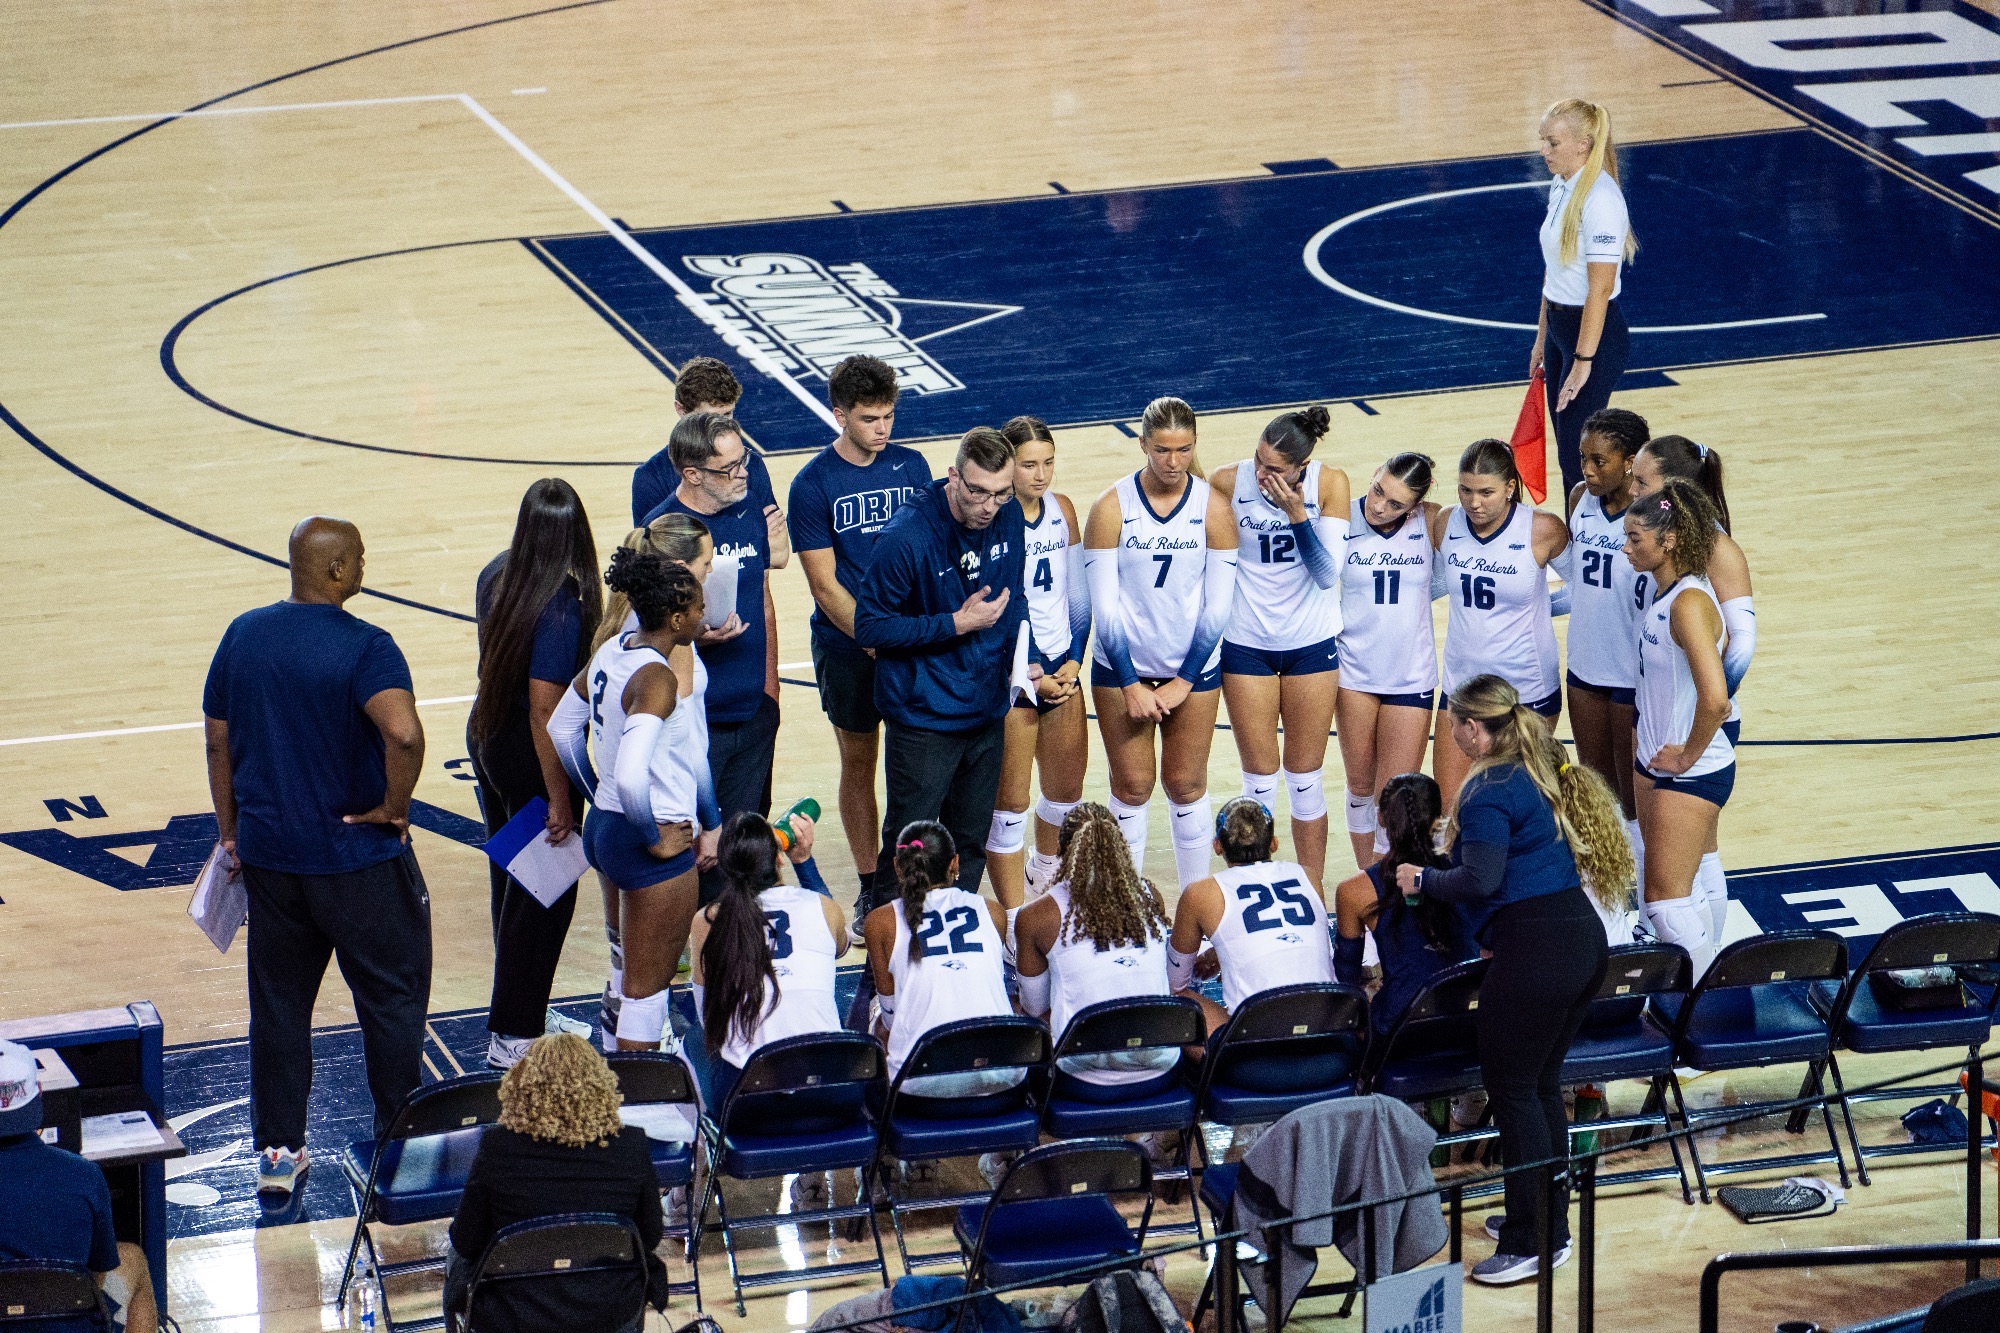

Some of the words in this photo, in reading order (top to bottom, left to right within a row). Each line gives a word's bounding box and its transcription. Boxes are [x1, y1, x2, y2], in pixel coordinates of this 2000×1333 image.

[828, 262, 901, 298] THE
[1239, 516, 1268, 531] Oral
[1575, 530, 1594, 545] Oral
[1594, 535, 1624, 551] Rober
[1033, 539, 1066, 556] Roberts
[1126, 535, 1155, 550] Oral
[1155, 536, 1199, 550] Roberts
[1257, 534, 1296, 563] 12
[1347, 551, 1377, 566] Oral
[1377, 552, 1425, 566] Roberts
[1033, 557, 1053, 592] 4
[1152, 554, 1173, 588] 7
[1448, 552, 1474, 569] Oral
[1472, 557, 1519, 575] Roberts
[1582, 549, 1614, 589] 21
[1372, 569, 1401, 605] 11
[1460, 572, 1496, 611] 16
[1634, 573, 1649, 611] 9
[1236, 878, 1316, 934] 25
[918, 905, 984, 957] 22
